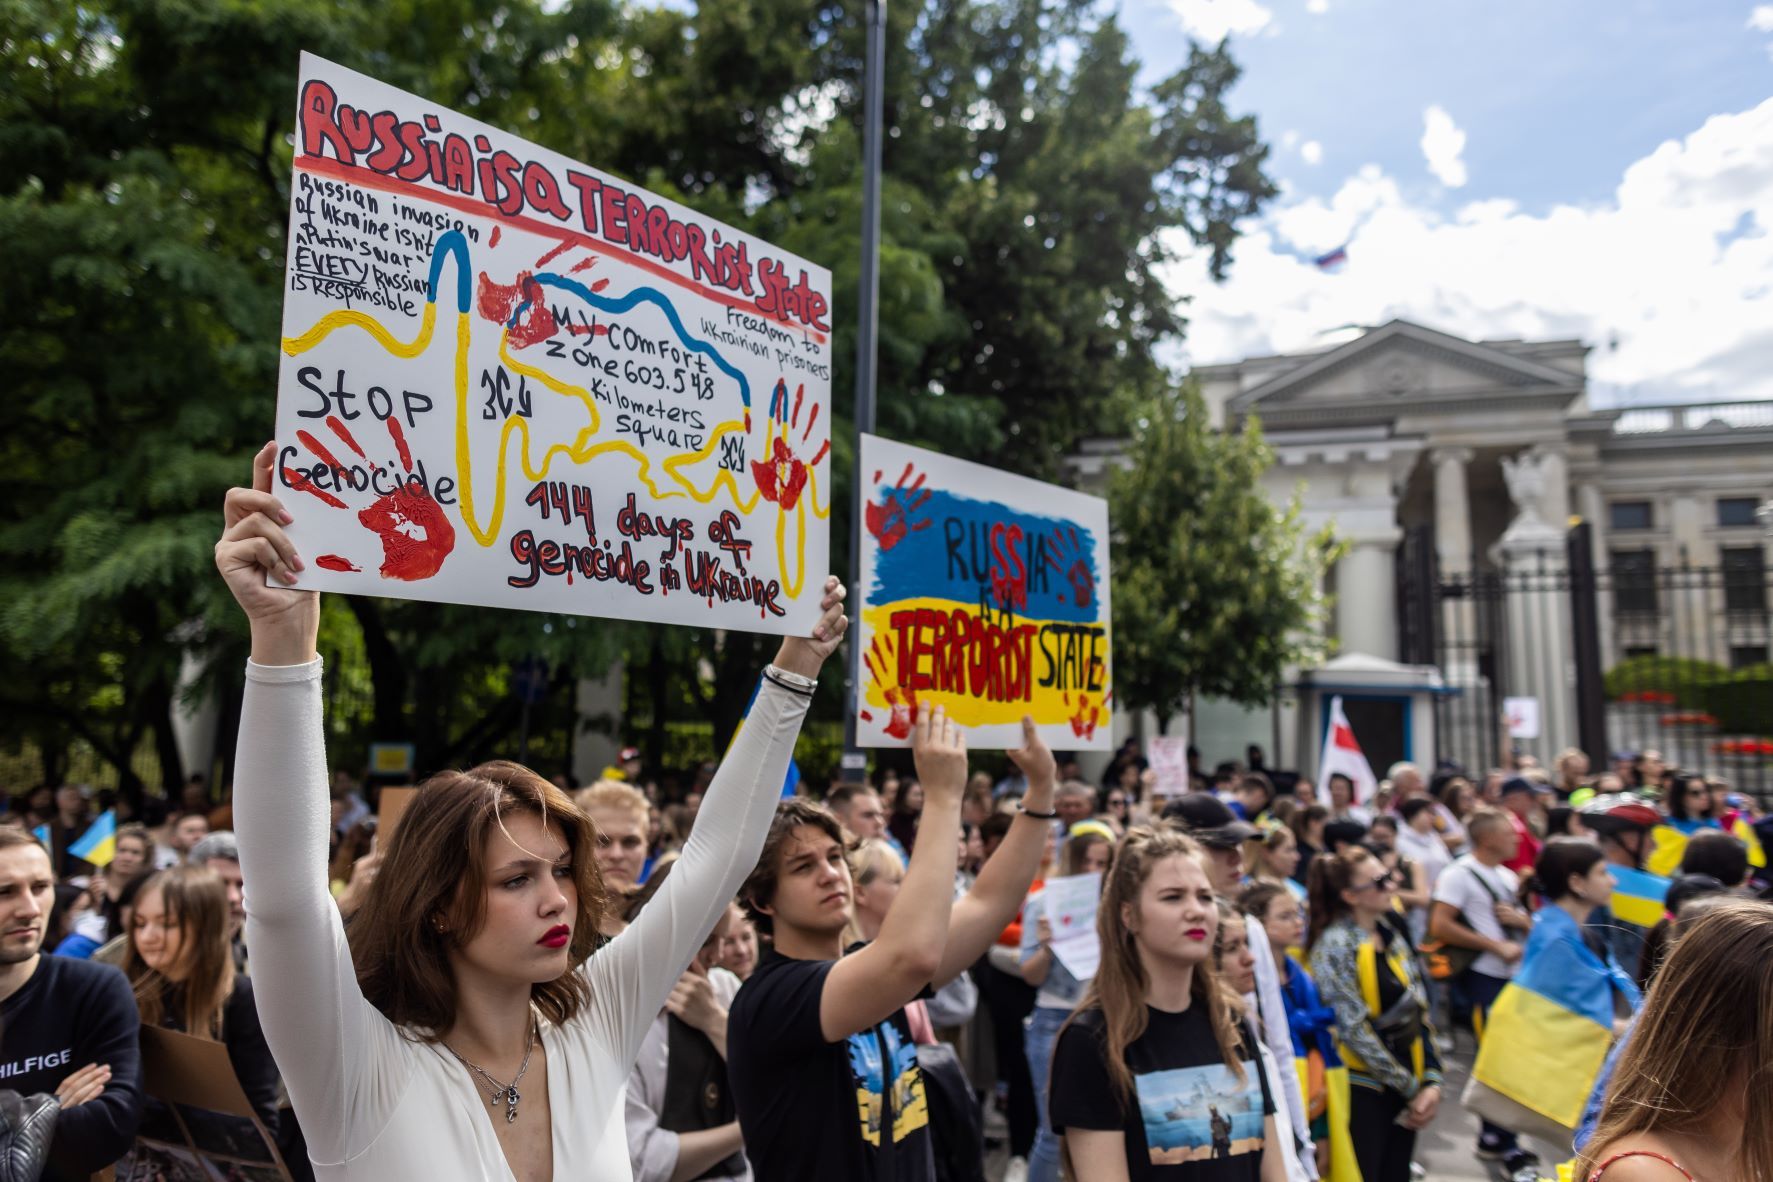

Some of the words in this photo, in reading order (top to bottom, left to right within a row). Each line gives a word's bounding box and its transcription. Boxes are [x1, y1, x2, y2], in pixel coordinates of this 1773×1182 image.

[299, 173, 378, 214] Russian
[393, 195, 479, 243] invasion
[394, 222, 435, 256] isn't
[372, 264, 432, 295] Russian
[755, 257, 831, 333] State
[552, 304, 596, 346] My
[727, 305, 795, 348] Freedom
[801, 330, 820, 354] to
[625, 360, 714, 400] 603.548
[776, 349, 829, 381] prisoners
[278, 446, 457, 505] Genocide
[526, 481, 595, 540] 144
[617, 493, 694, 560] days
[708, 510, 752, 569] of
[508, 530, 654, 595] genocide
[660, 558, 681, 590] in
[944, 517, 1049, 594] RUSSIA
[890, 608, 1038, 703] TERRORIST
[1038, 622, 1105, 692] STATE
